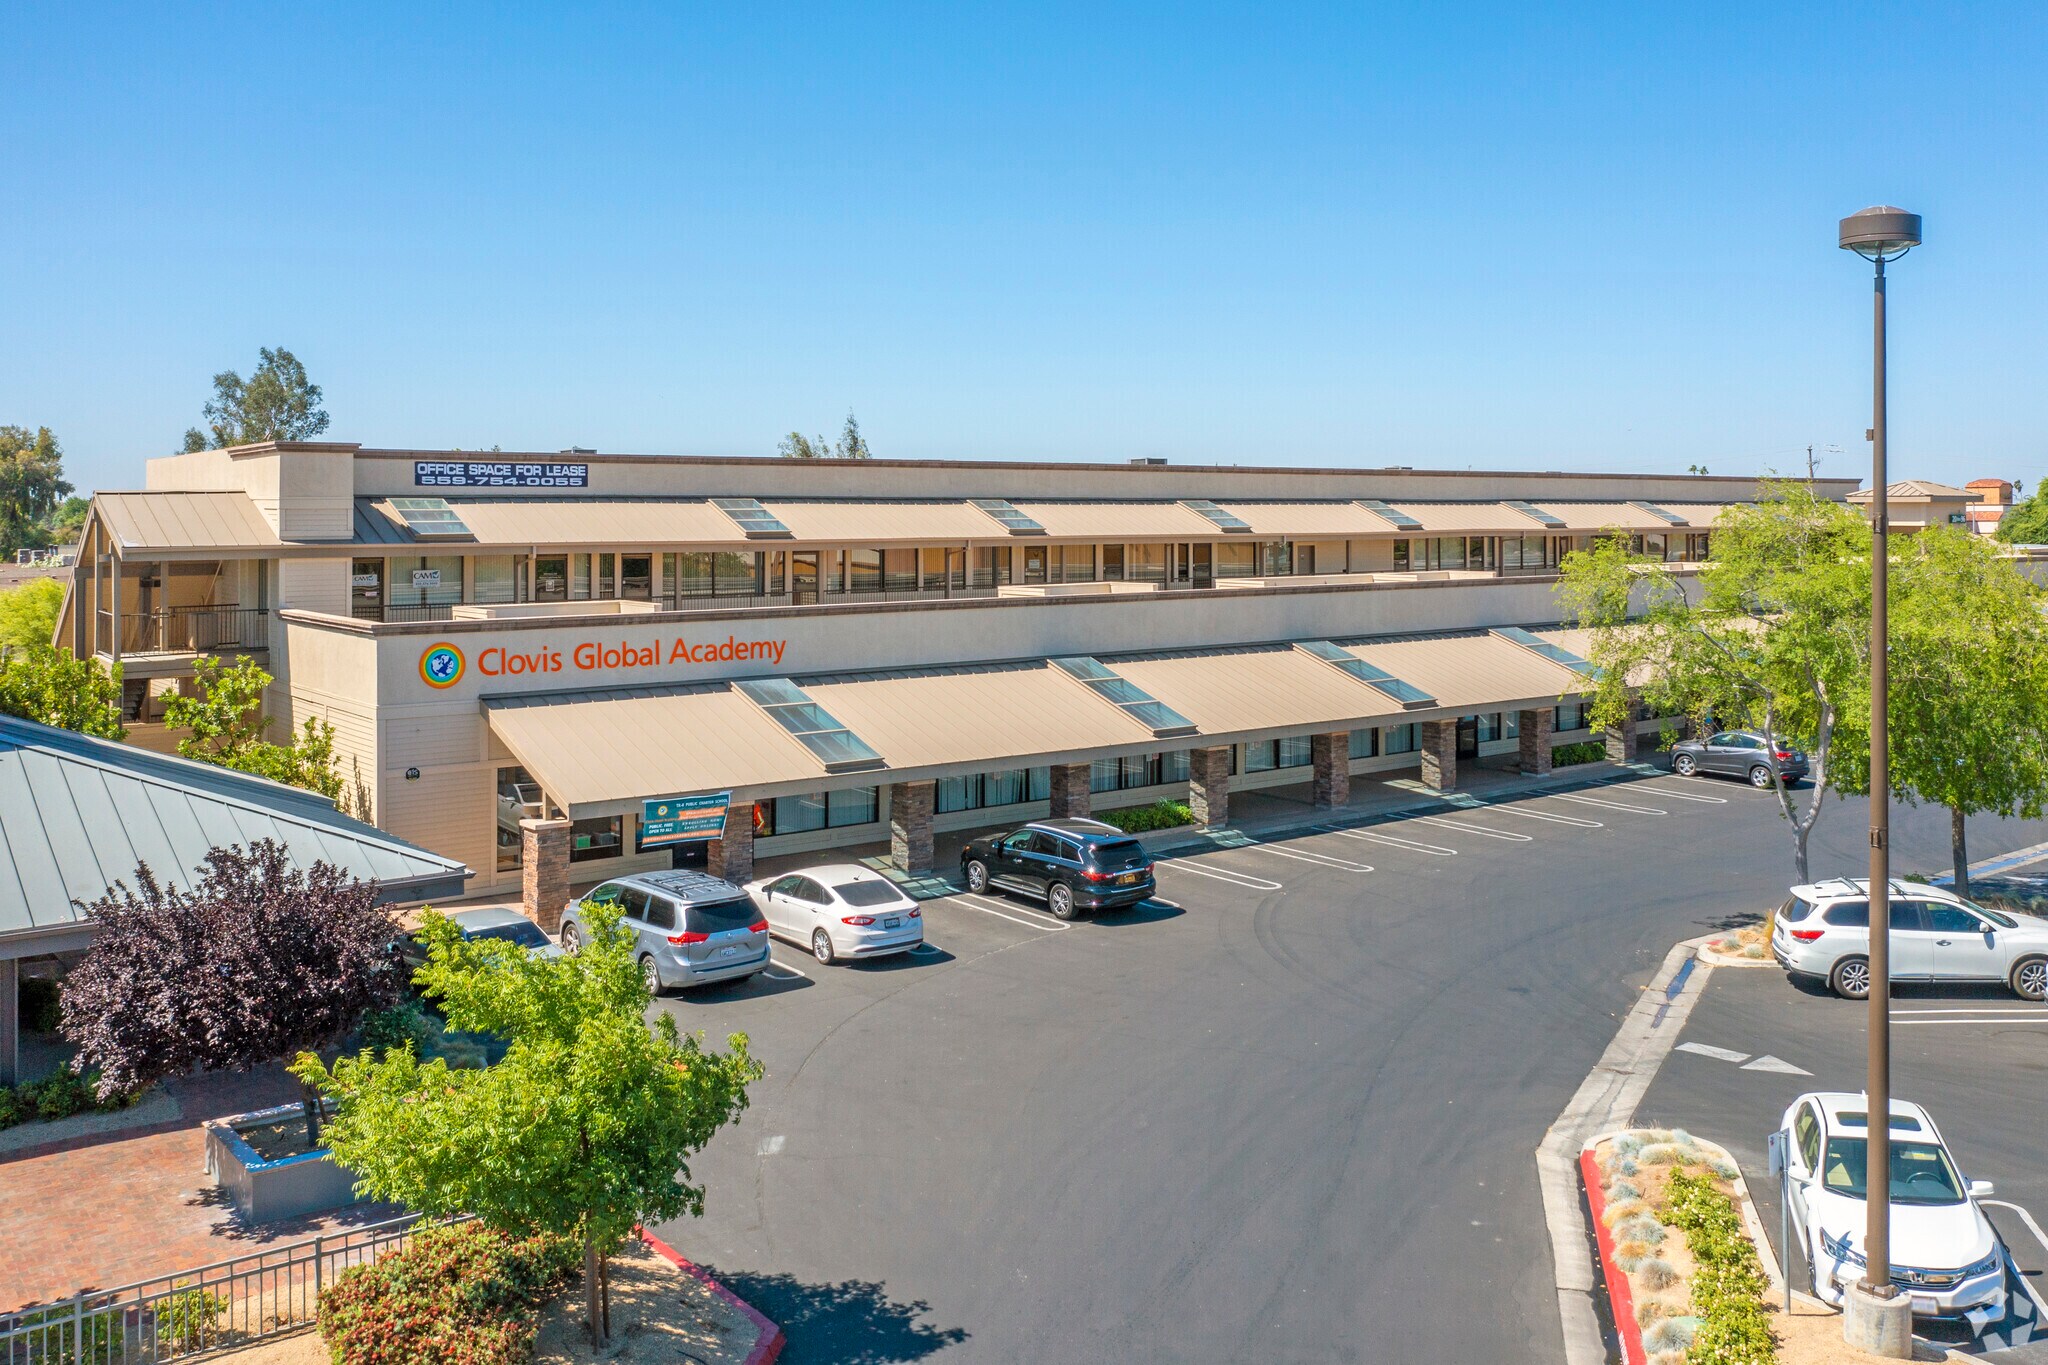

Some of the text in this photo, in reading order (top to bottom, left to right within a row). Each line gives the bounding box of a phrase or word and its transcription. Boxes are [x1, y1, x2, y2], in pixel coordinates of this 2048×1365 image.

[417, 462, 586, 477] OFFICE SPACE FOR LEASE
[421, 476, 583, 486] 559-754-0055
[478, 636, 786, 676] Clovis Global Academy
